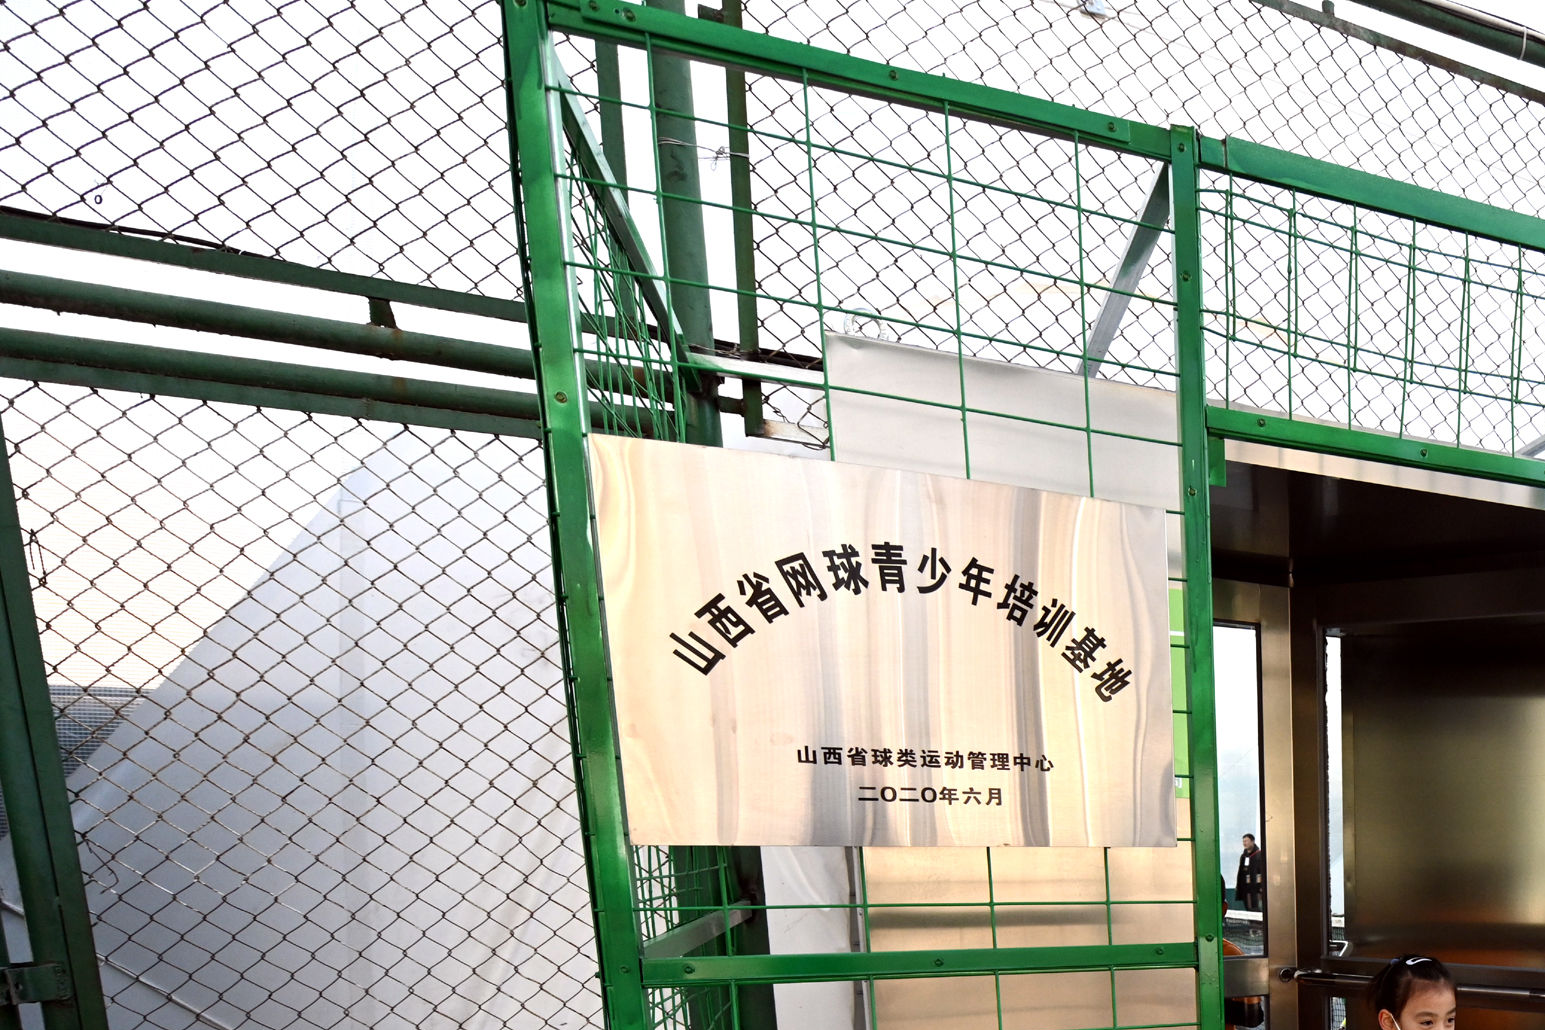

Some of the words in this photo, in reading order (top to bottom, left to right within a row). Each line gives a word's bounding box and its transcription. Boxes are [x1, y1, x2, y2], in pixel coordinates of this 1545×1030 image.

[669, 542, 1134, 704] 山西省网球青少年培训基地
[797, 745, 1054, 772] 山西省球类运动管理中心
